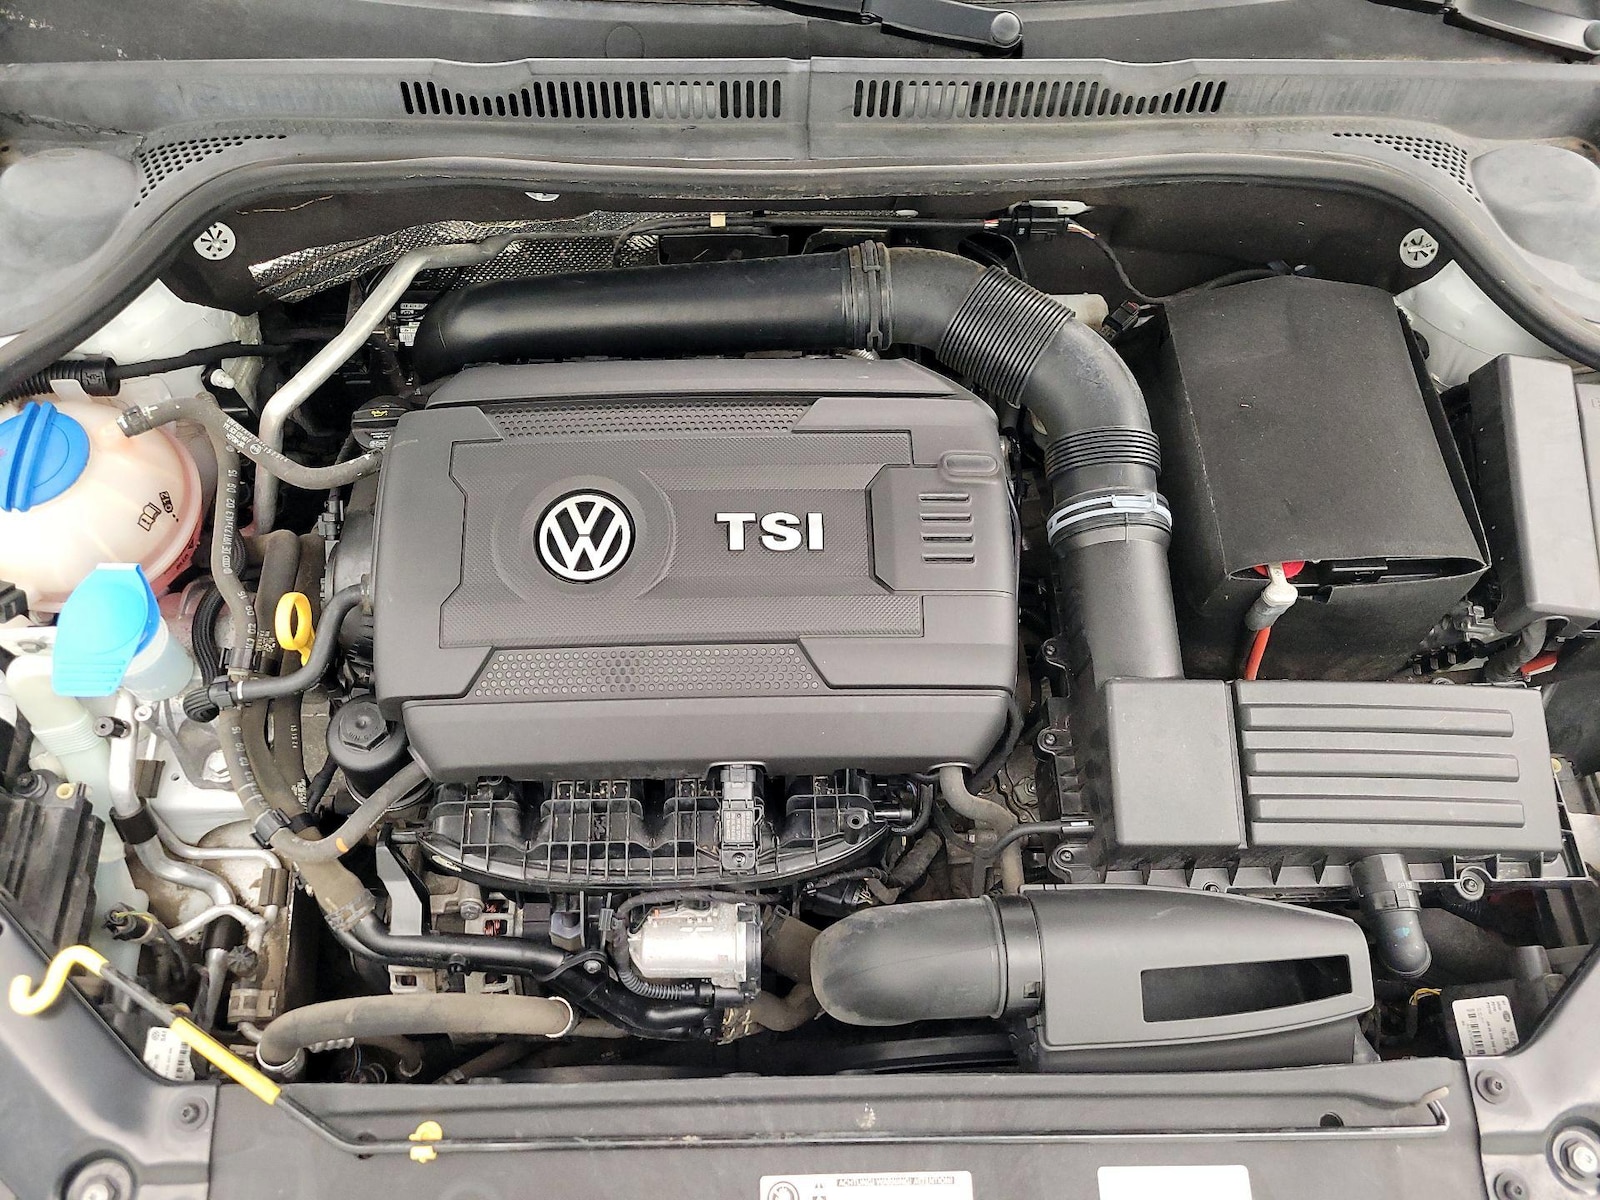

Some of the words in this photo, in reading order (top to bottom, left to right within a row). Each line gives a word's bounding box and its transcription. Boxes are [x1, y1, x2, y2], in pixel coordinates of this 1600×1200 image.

[227, 469, 238, 478] 15
[540, 494, 631, 581] VW
[714, 511, 825, 552] TSI
[237, 590, 248, 600] 15
